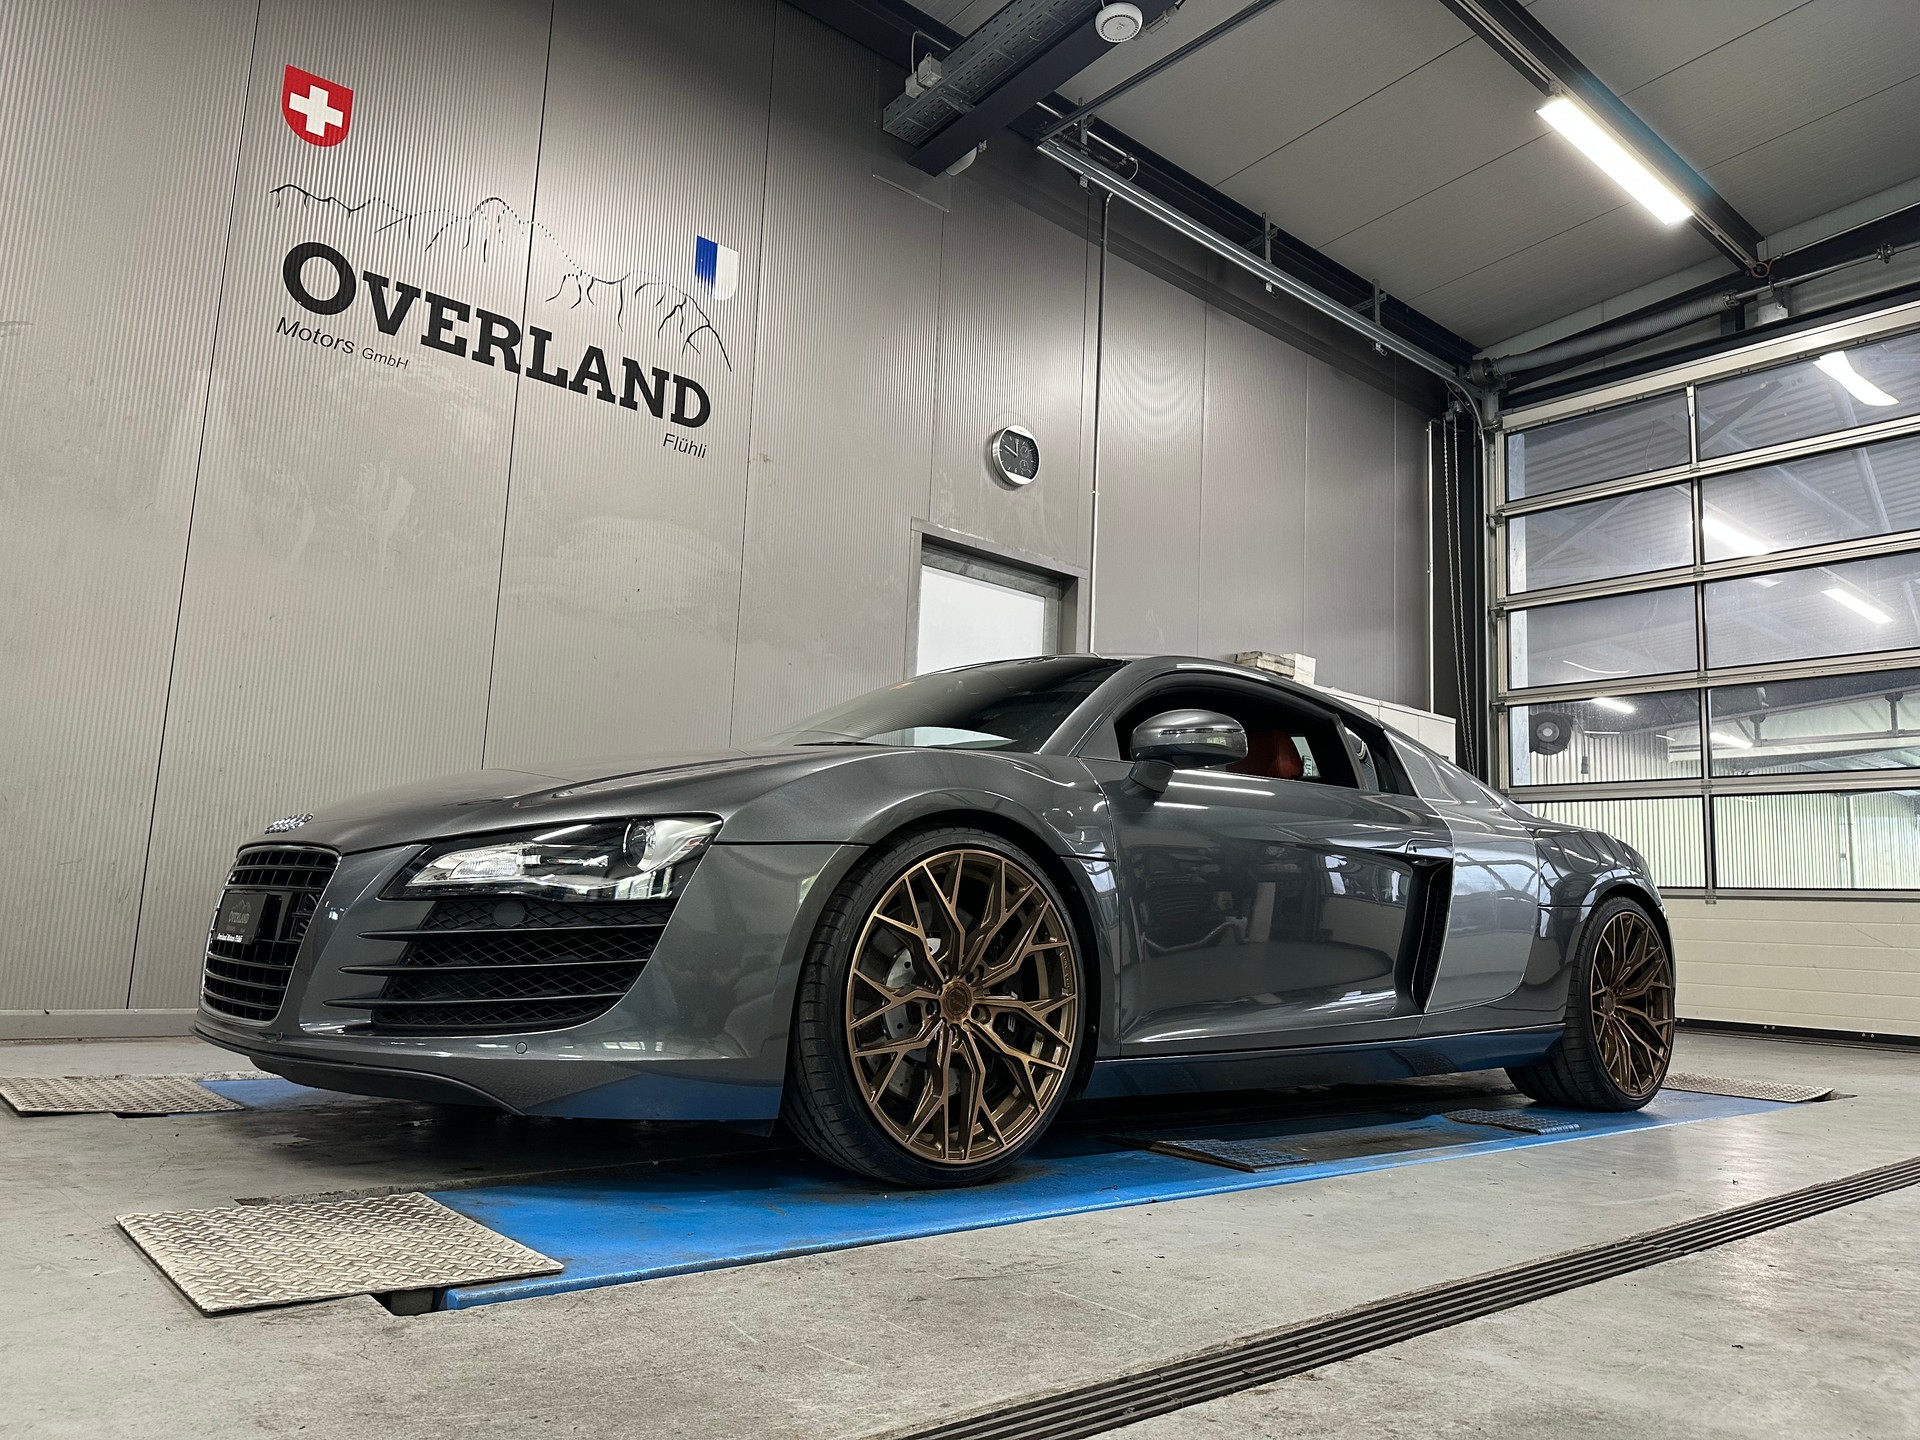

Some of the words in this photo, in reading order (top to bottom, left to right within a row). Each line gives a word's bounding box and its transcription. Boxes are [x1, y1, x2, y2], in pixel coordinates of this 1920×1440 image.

[276, 316, 355, 354] Motors
[362, 347, 409, 369] GmbH
[283, 241, 711, 428] OVERLAND
[662, 432, 707, 459] Flühli
